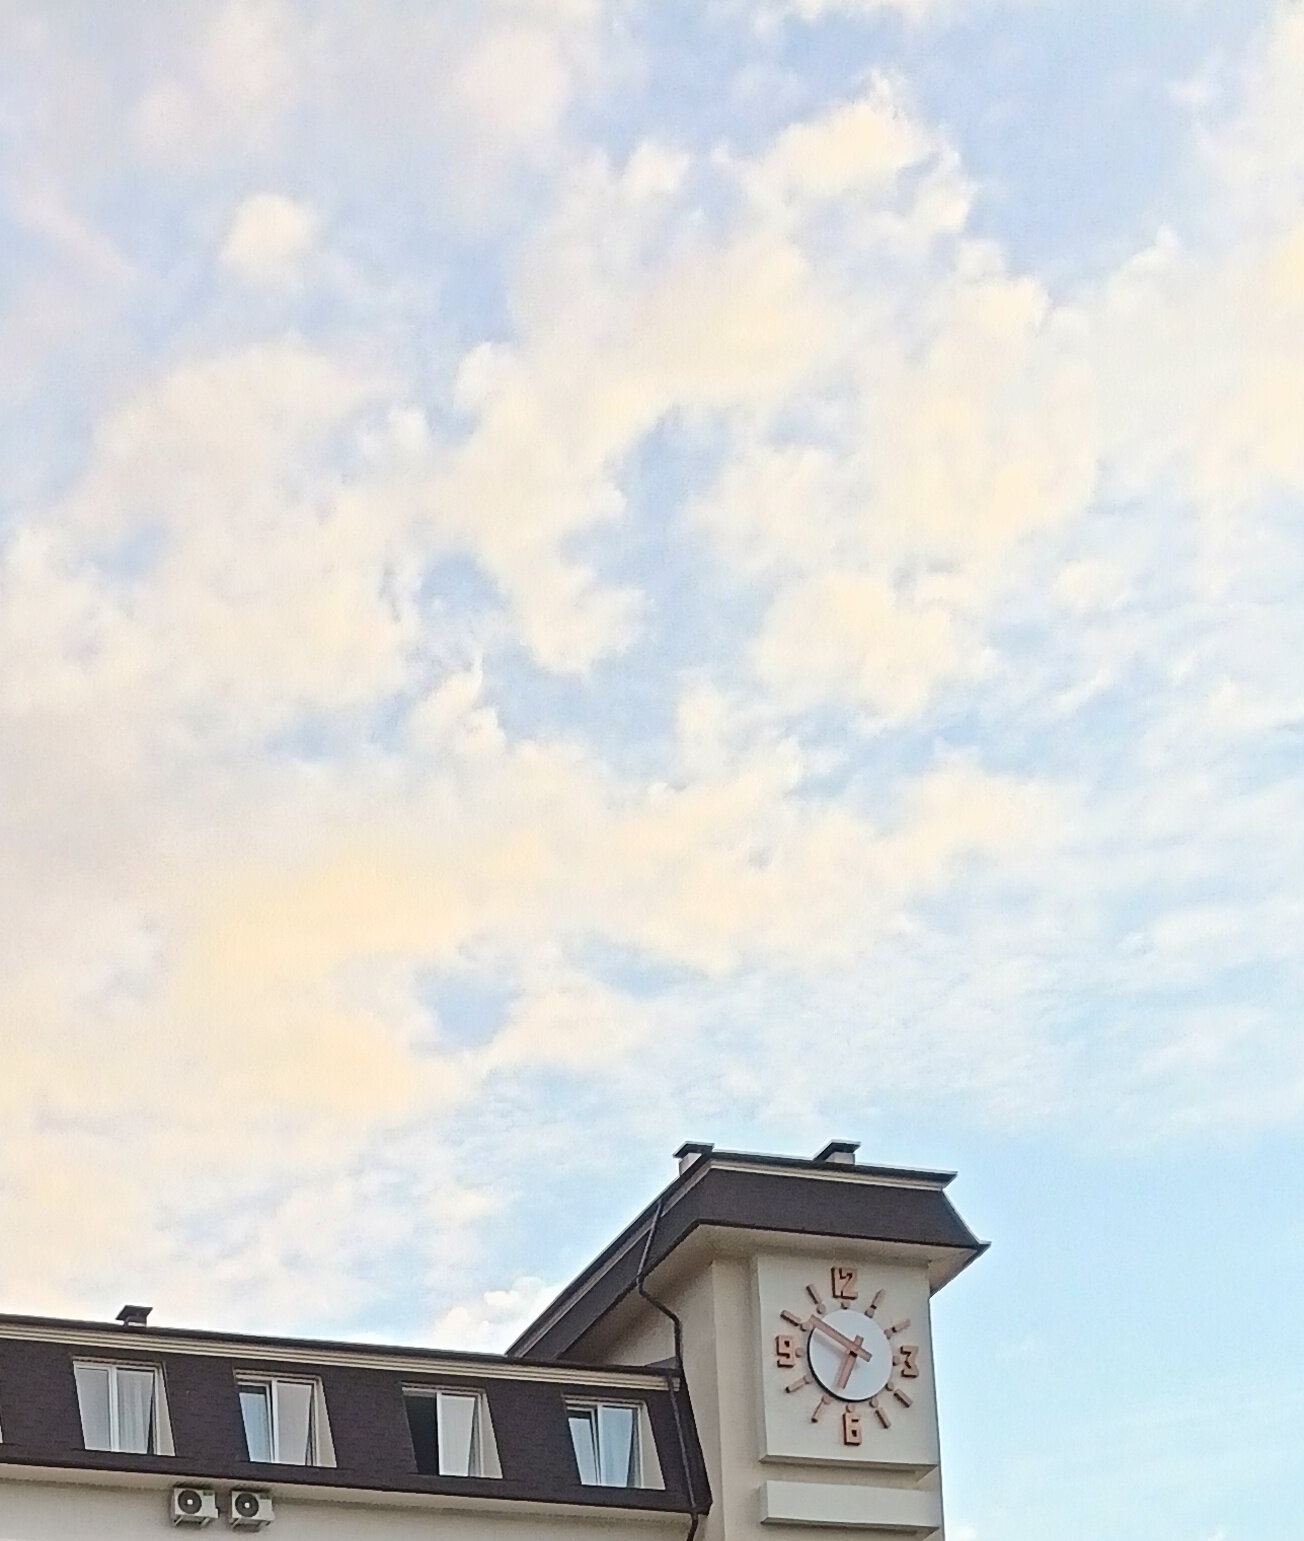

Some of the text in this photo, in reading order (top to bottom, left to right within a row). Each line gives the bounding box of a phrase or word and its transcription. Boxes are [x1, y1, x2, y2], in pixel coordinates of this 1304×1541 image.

[831, 1267, 858, 1300] 12
[776, 1335, 796, 1368] 9
[900, 1345, 919, 1378] 3
[843, 1412, 862, 1446] 6
